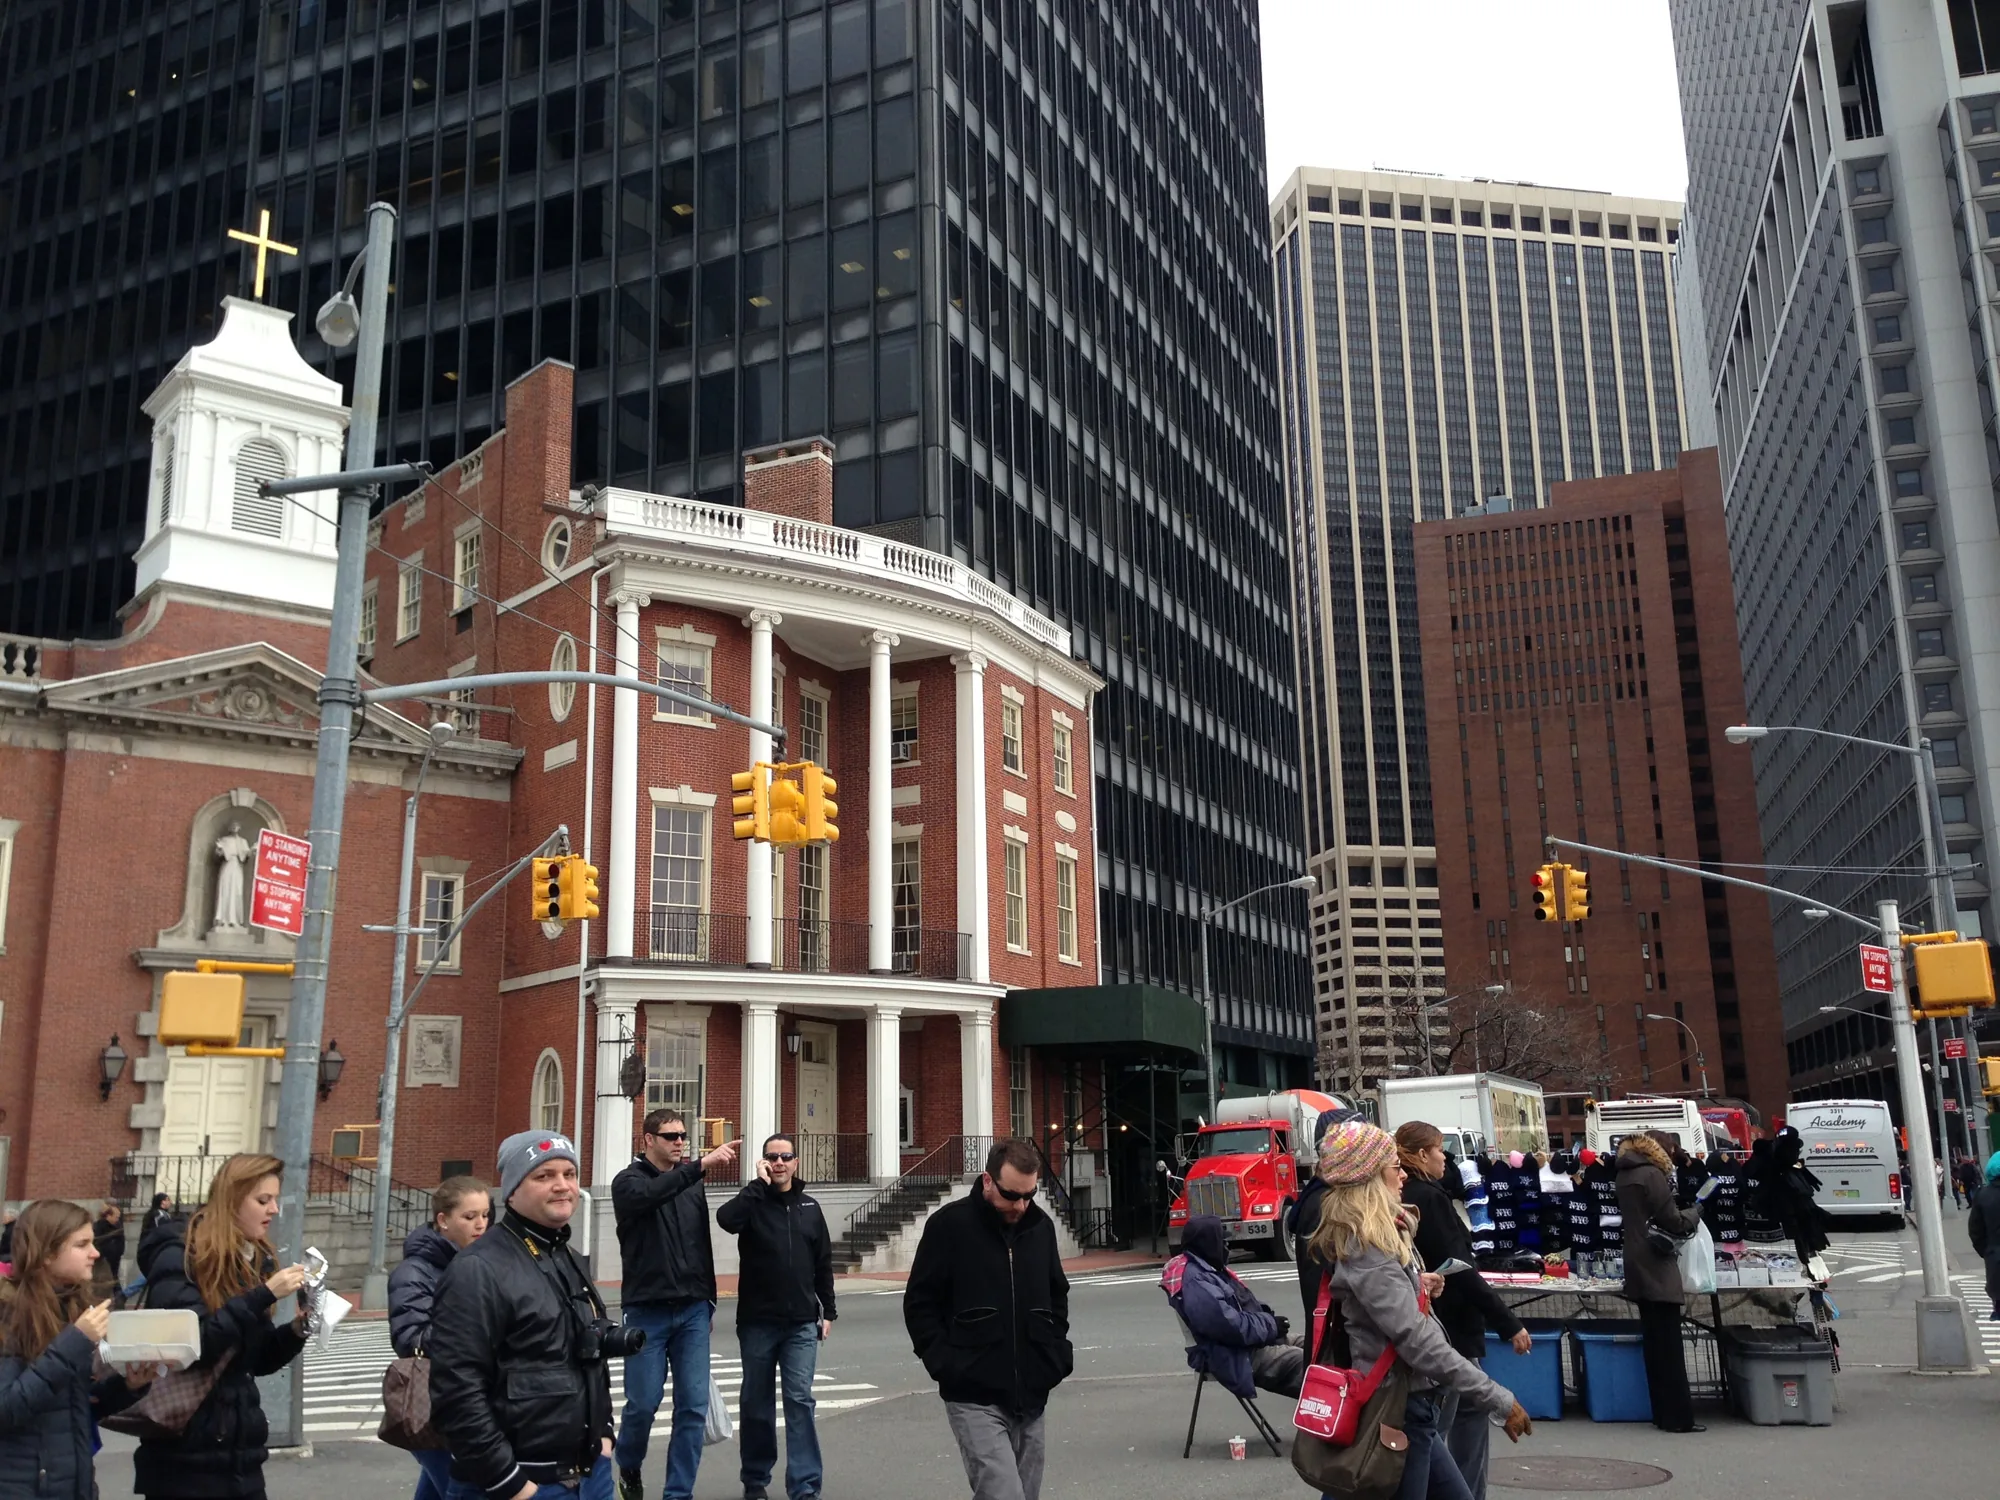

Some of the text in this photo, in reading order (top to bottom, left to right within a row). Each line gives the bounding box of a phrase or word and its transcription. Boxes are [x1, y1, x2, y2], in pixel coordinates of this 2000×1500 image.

[262, 835, 308, 857] NO STANDING
[266, 850, 300, 868] ANYTIME
[258, 882, 301, 902] NO STOPPING
[264, 898, 292, 913] ANYTIME
[1863, 951, 1888, 963] NO STOPPING
[1870, 964, 1886, 974] ANYTIME
[1810, 1115, 1866, 1129] Academy
[526, 1146, 537, 1160] I
[1718, 1176, 1736, 1184] NYC
[1491, 1182, 1509, 1190] NYC
[1591, 1182, 1608, 1191] NYC
[1569, 1201, 1587, 1211] NYC
[1601, 1205, 1618, 1214] NYC
[1496, 1208, 1512, 1217] NYC
[1571, 1215, 1589, 1224] NYC
[1248, 1225, 1267, 1234] 538
[1499, 1221, 1516, 1230] NYC
[1572, 1233, 1590, 1244] NYC
[1602, 1231, 1620, 1240] NYC
[1721, 1230, 1739, 1239] NYC
[1604, 1248, 1620, 1257] NYC
